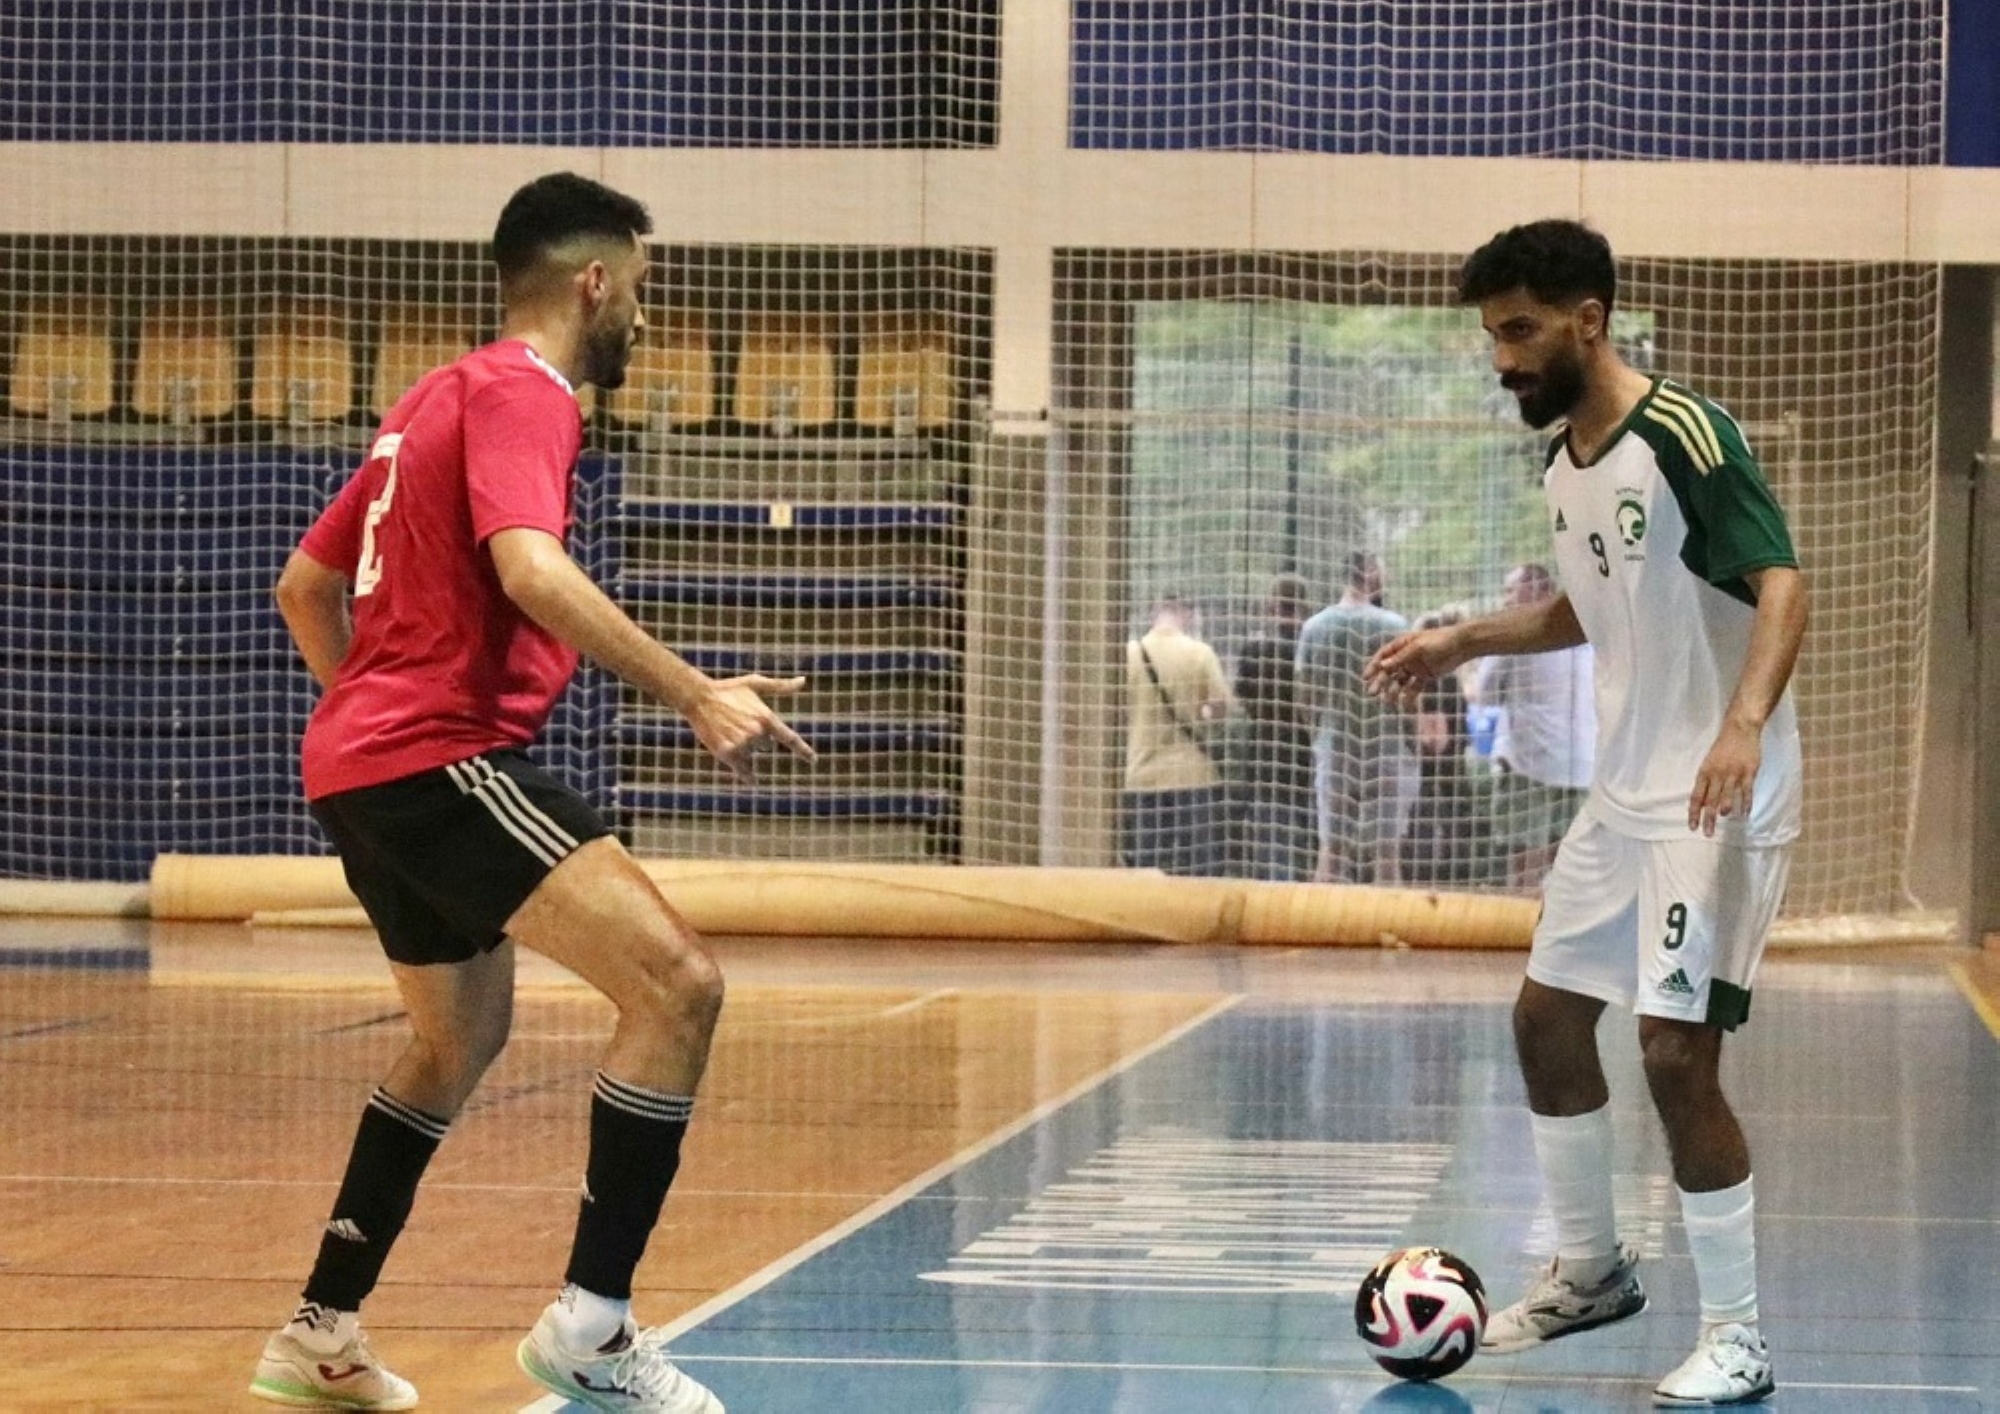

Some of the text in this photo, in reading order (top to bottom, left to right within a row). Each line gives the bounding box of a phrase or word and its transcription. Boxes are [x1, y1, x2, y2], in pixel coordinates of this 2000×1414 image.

[354, 433, 403, 597] 2
[1588, 532, 1609, 577] 9
[1664, 902, 1687, 950] 9
